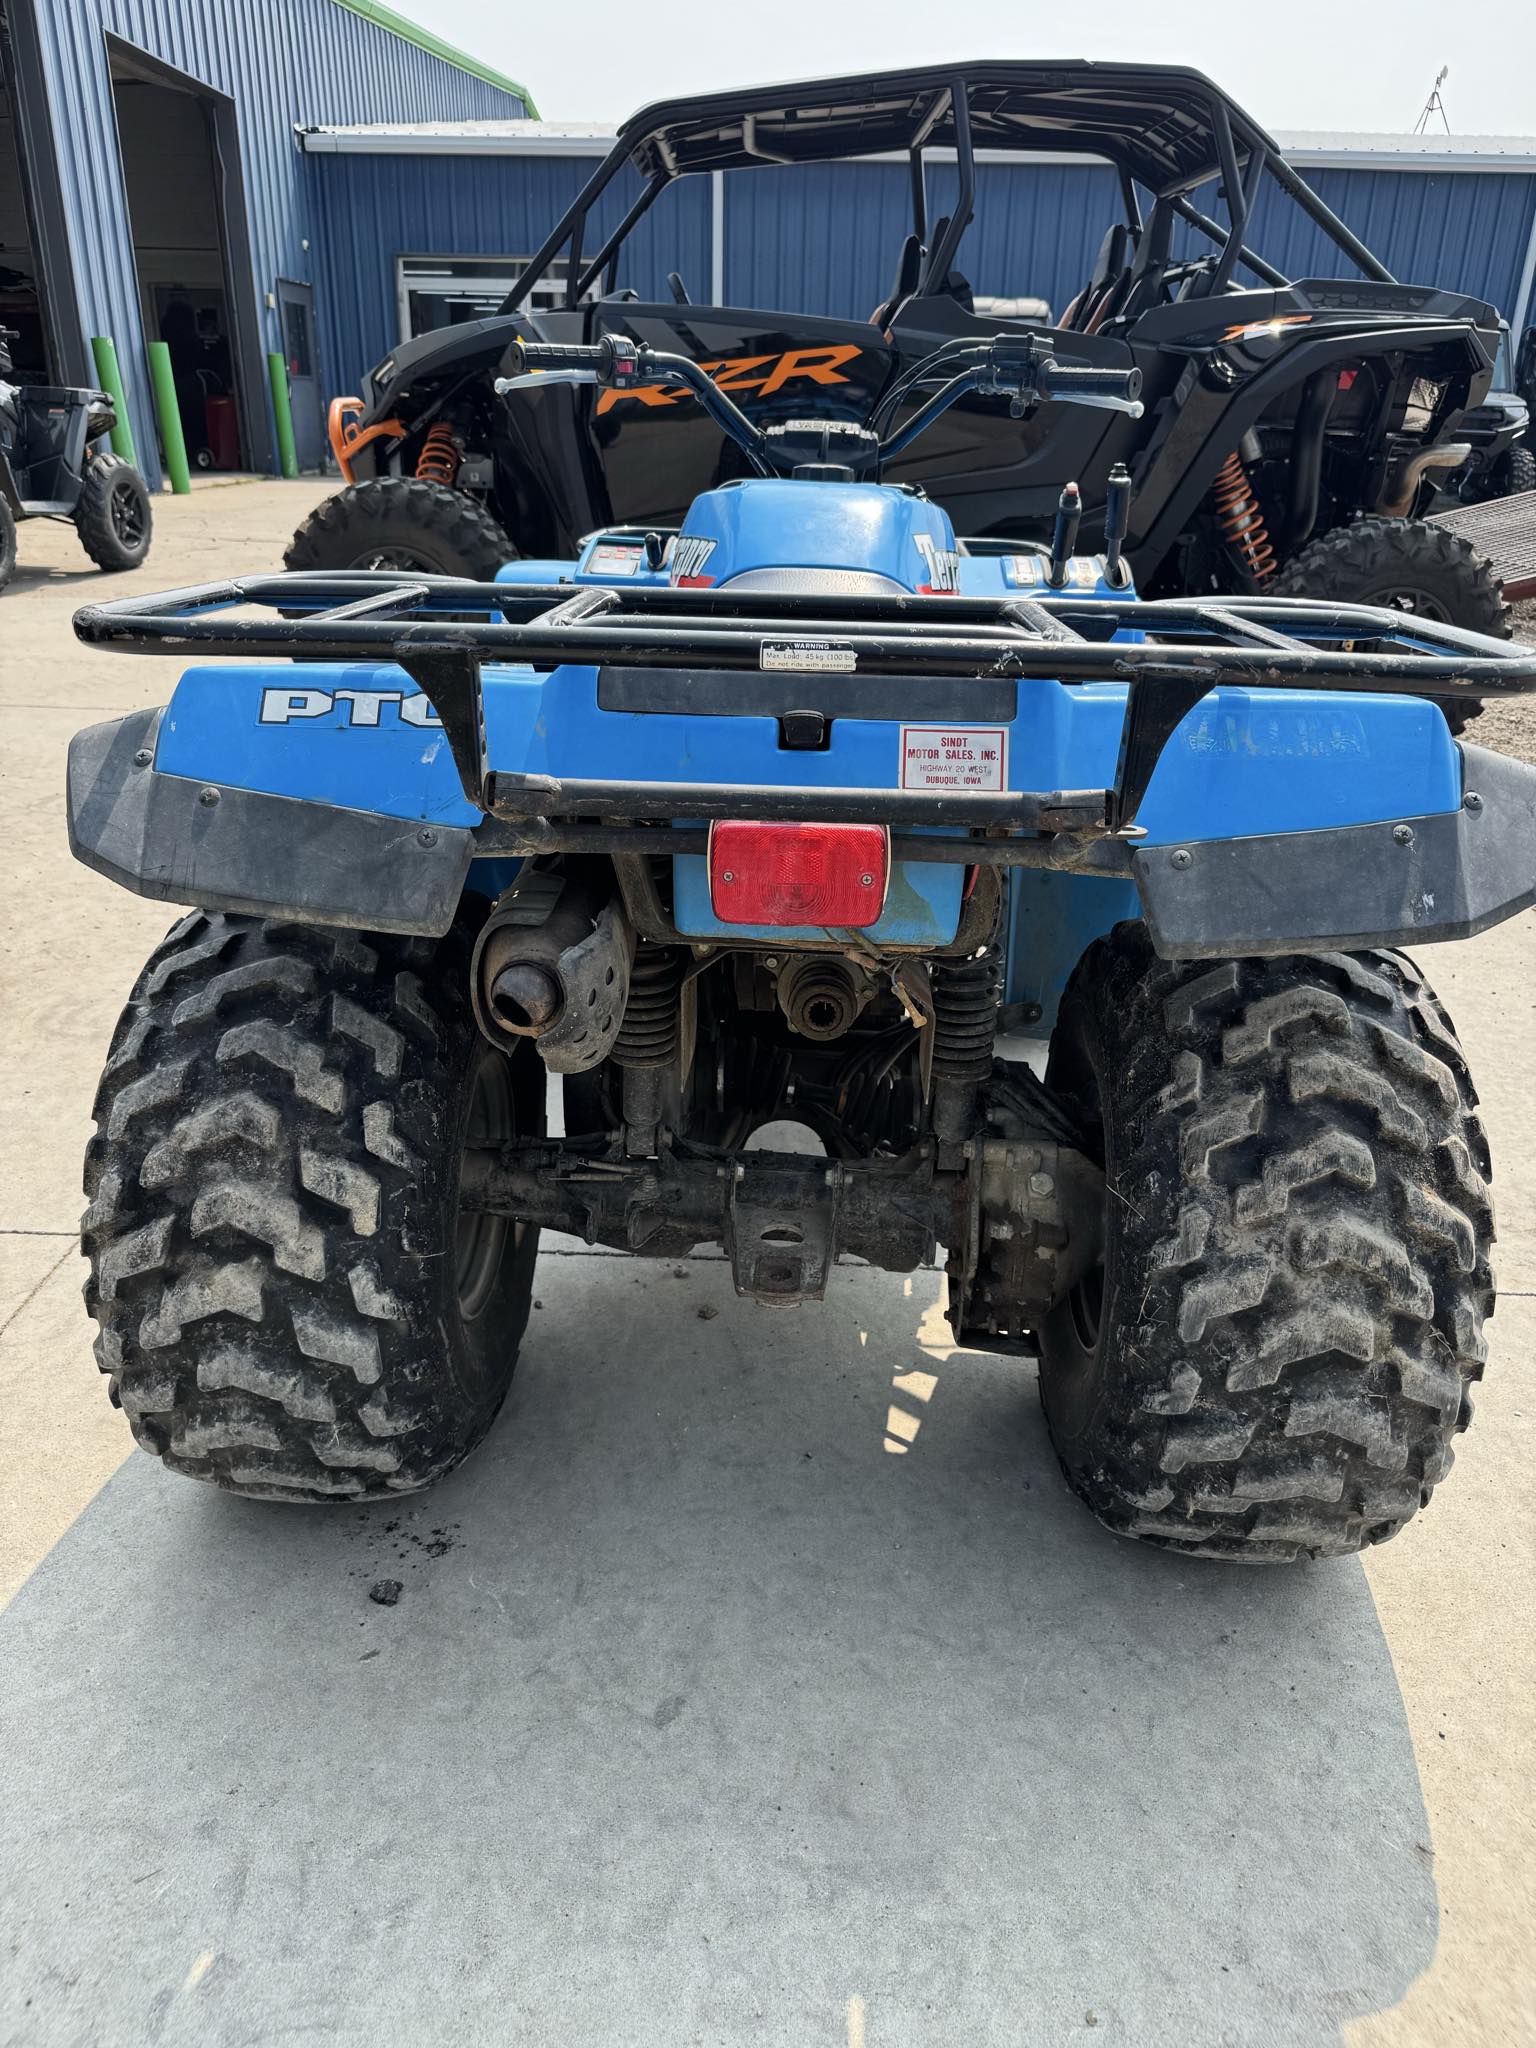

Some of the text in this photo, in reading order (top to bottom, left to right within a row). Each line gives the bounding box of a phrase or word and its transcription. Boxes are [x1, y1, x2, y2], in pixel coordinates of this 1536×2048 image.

[596, 344, 863, 416] RZR
[794, 642, 830, 650] WARNING
[815, 653, 824, 661] kg
[941, 737, 968, 748] SINDT
[907, 748, 939, 760] MOTOR
[981, 750, 999, 761] INC.
[920, 764, 952, 773] HIGHWAY
[955, 765, 965, 774] 20
[963, 776, 982, 785] IOWA
